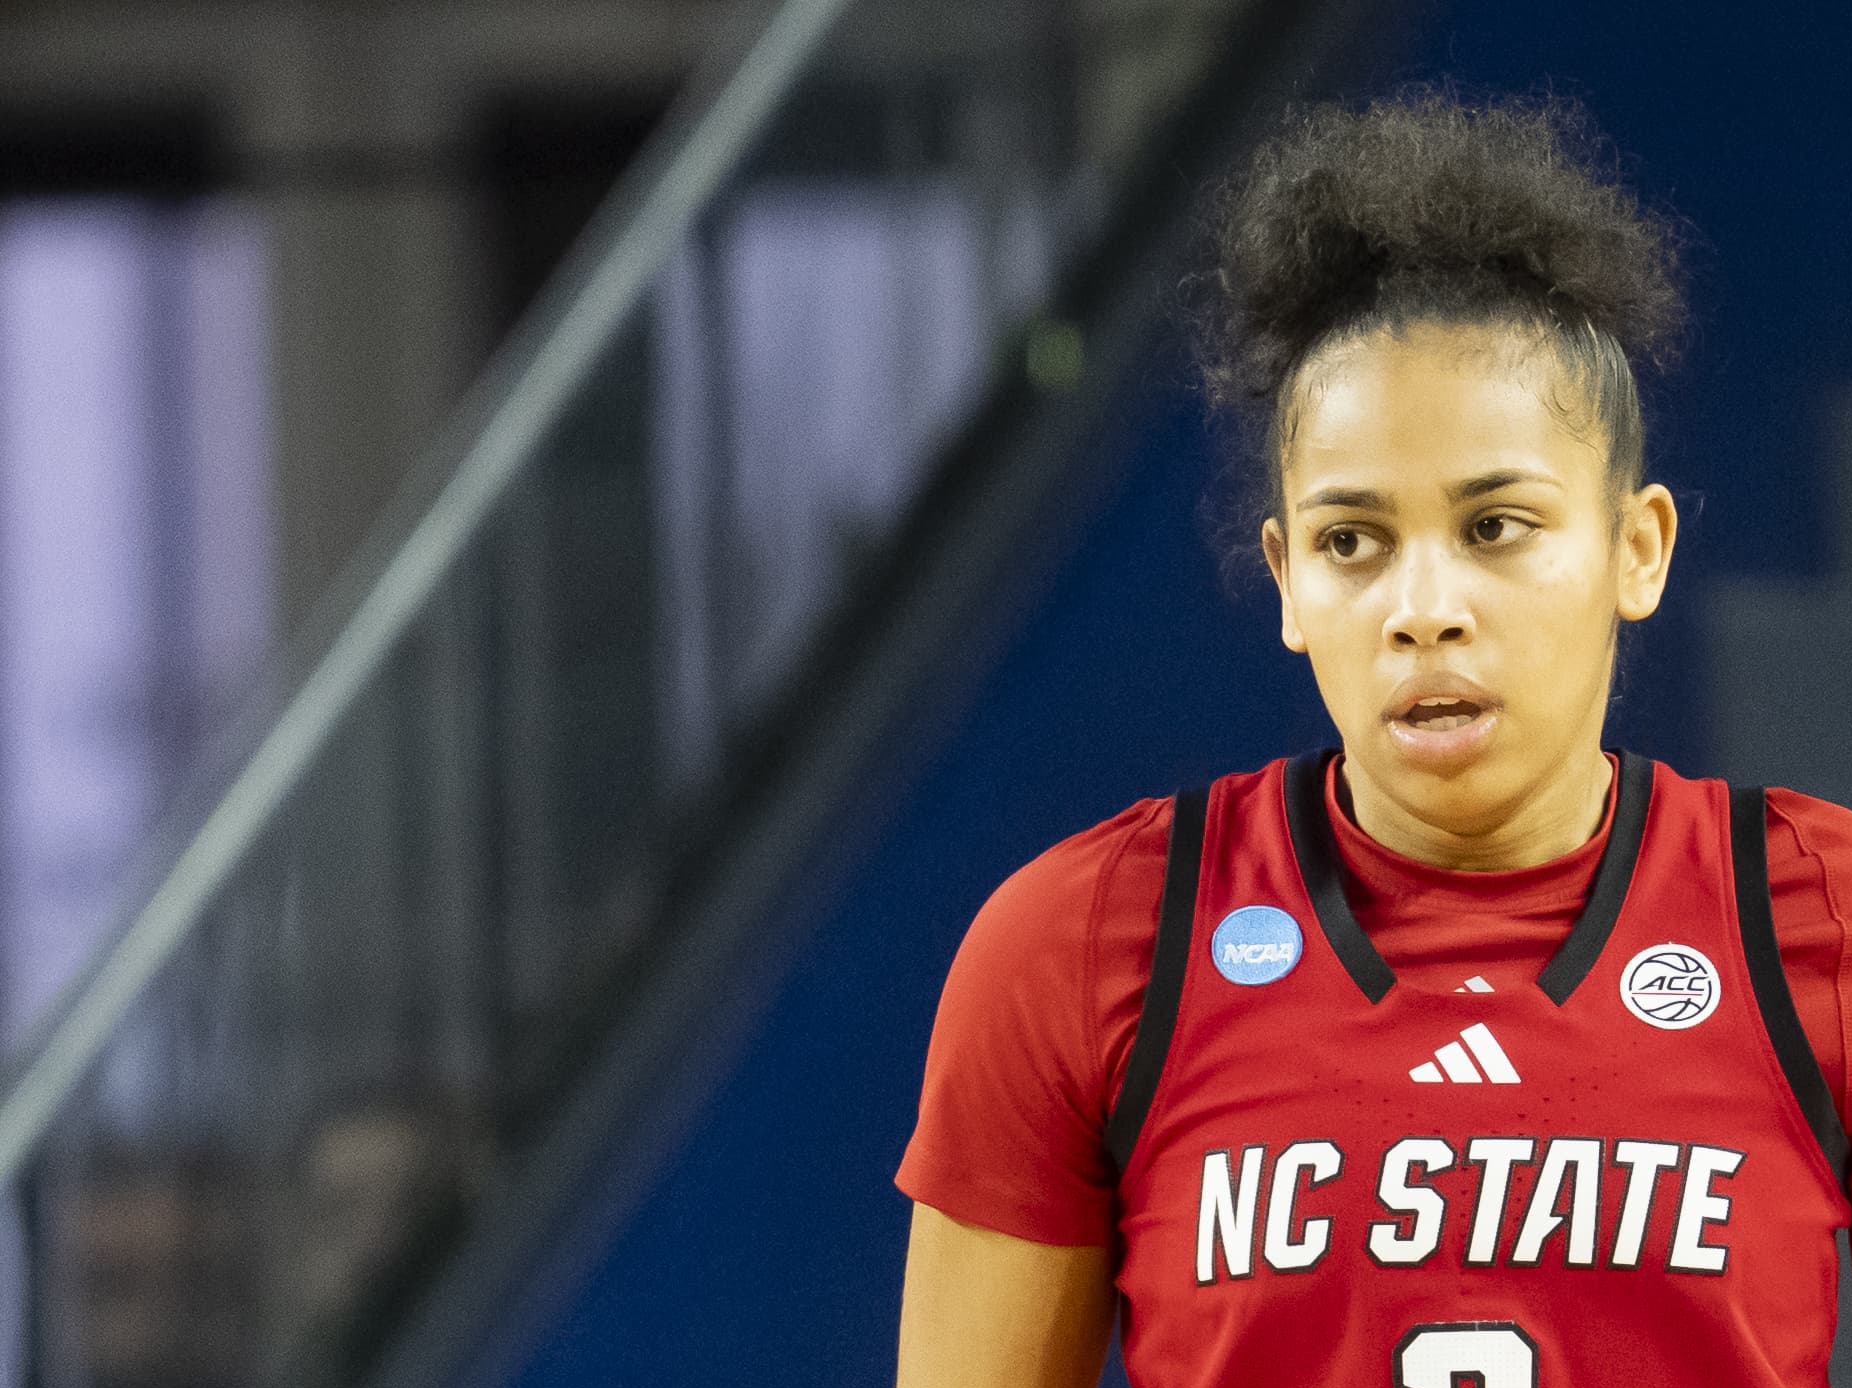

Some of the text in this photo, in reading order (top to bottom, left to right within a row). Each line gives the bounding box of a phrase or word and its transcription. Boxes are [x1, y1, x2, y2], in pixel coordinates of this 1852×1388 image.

[1222, 942, 1295, 964] NCAA
[1639, 975, 1709, 992] ACC
[1195, 1137, 1747, 1287] NC STATE
